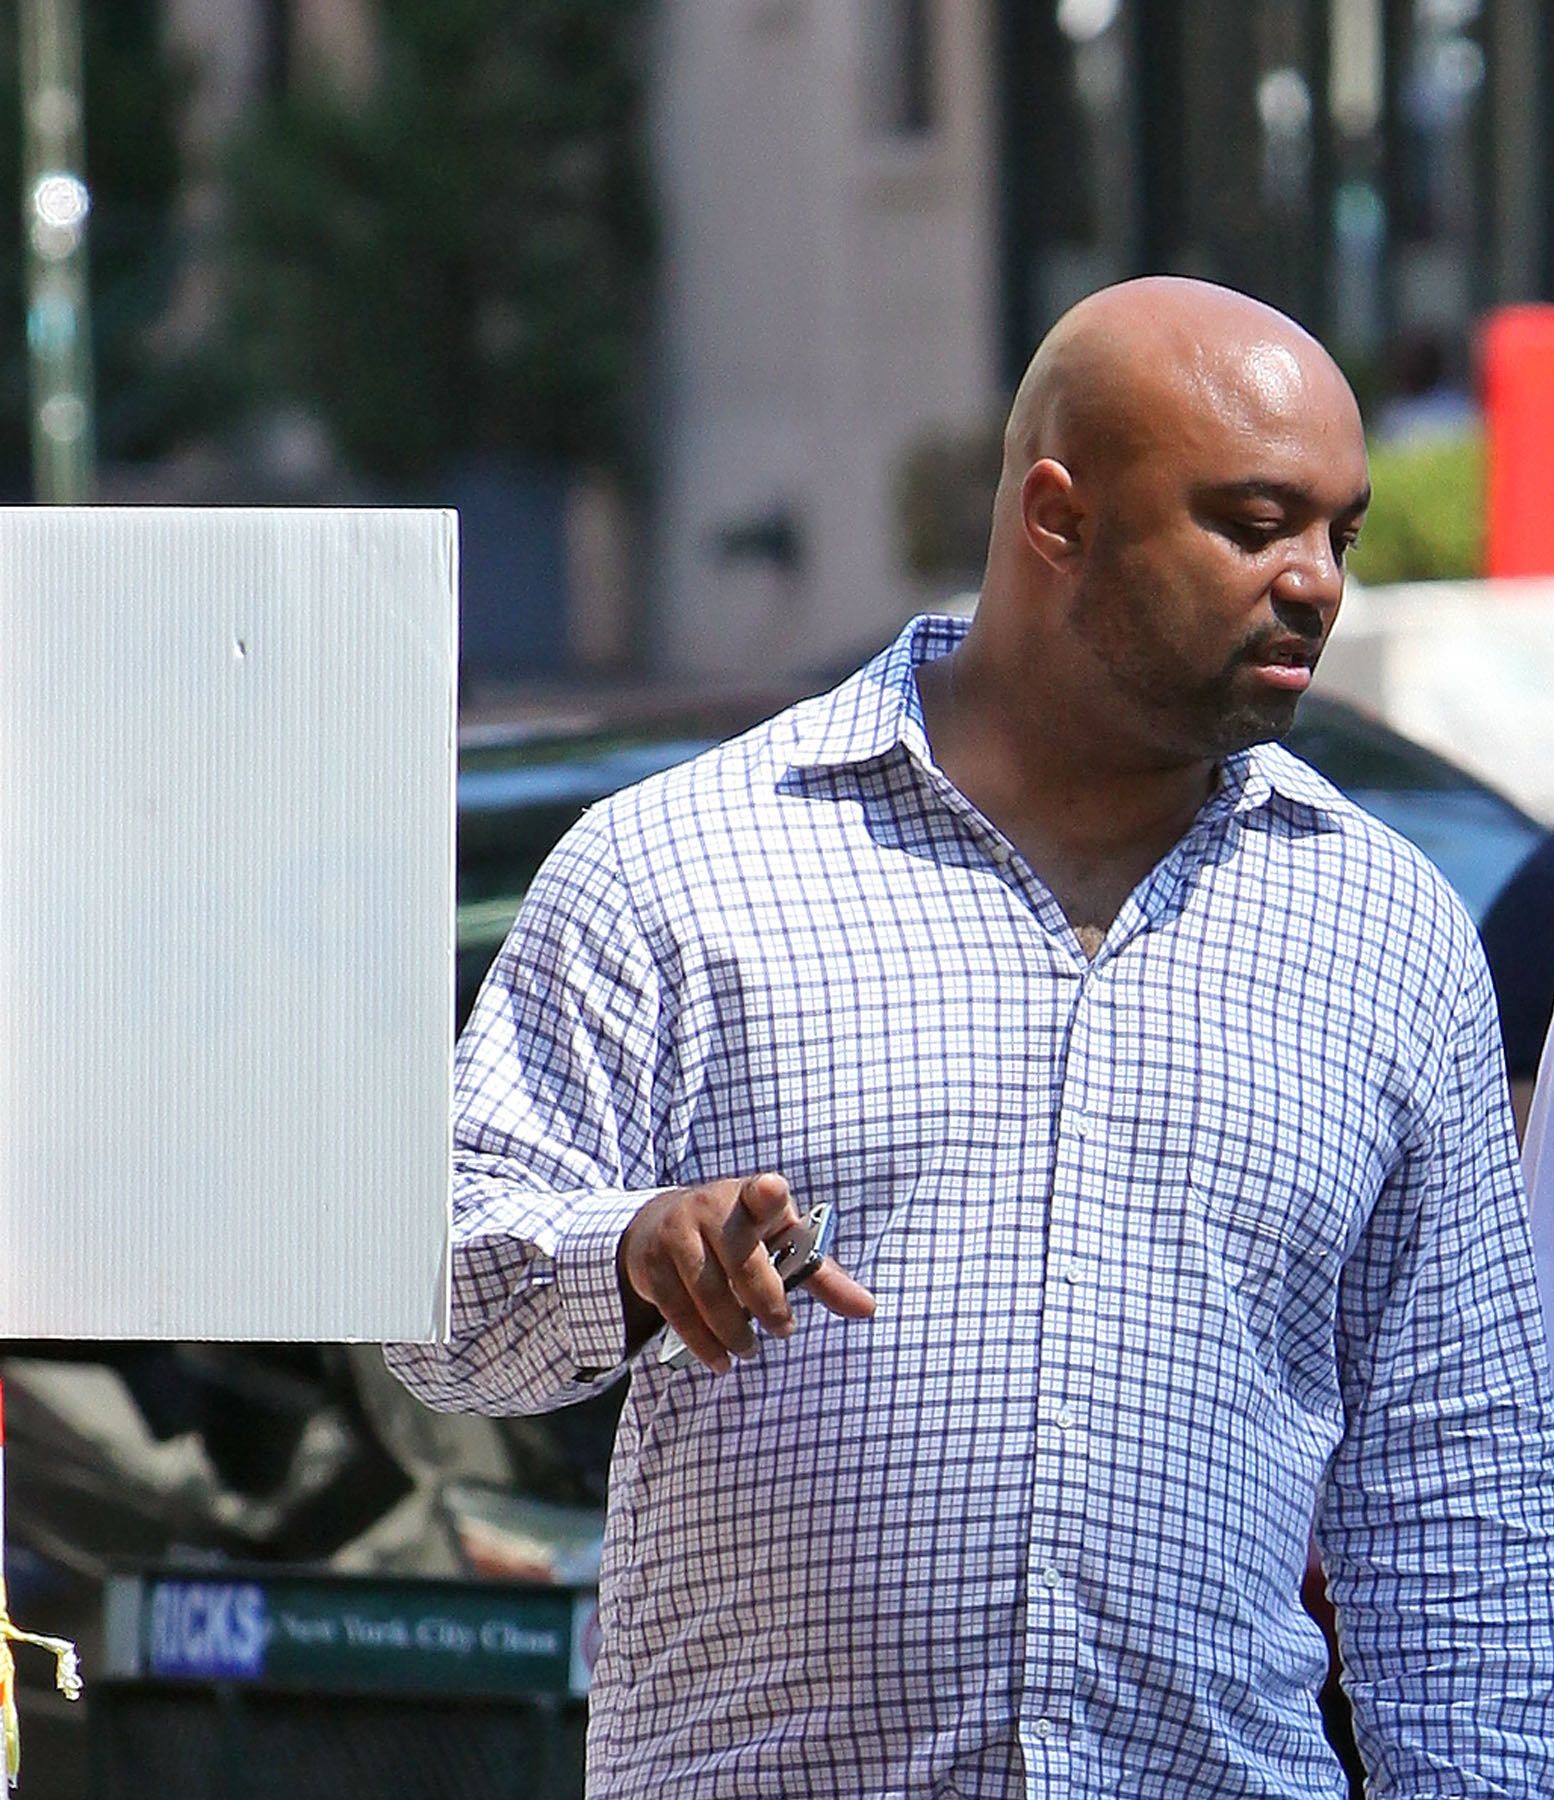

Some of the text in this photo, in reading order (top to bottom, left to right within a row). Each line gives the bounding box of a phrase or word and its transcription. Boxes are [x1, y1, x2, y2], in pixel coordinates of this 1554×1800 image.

[281, 1611, 334, 1643] New
[342, 1613, 409, 1648] York
[416, 1616, 473, 1657] City
